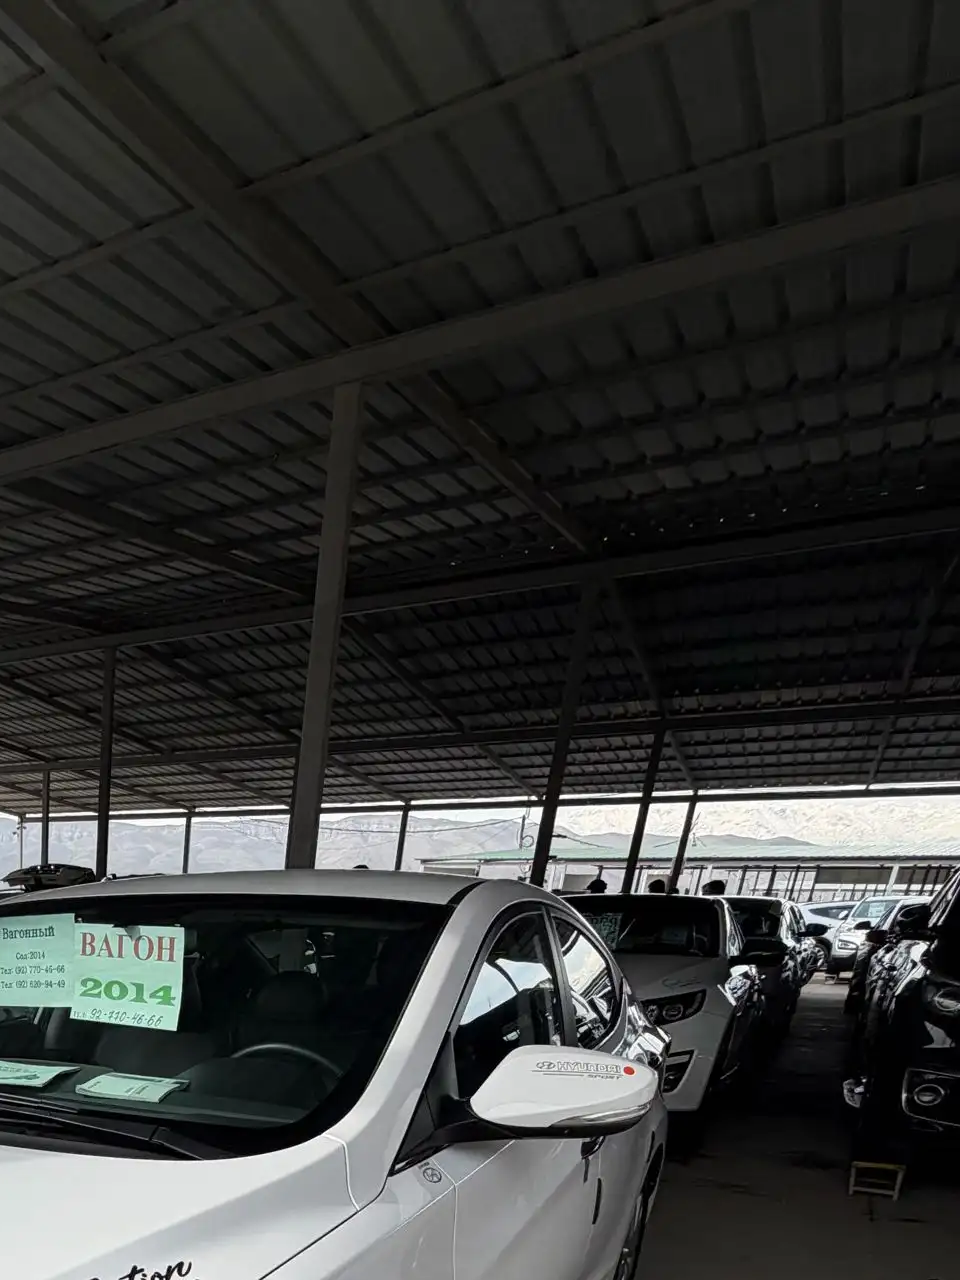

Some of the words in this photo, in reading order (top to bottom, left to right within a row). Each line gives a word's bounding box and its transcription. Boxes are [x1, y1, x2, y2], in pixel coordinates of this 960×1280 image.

[2, 925, 55, 940] Вагонный
[80, 932, 177, 963] ВАГОН
[79, 977, 176, 1007] 2014
[557, 1061, 621, 1073] HYUNDAI
